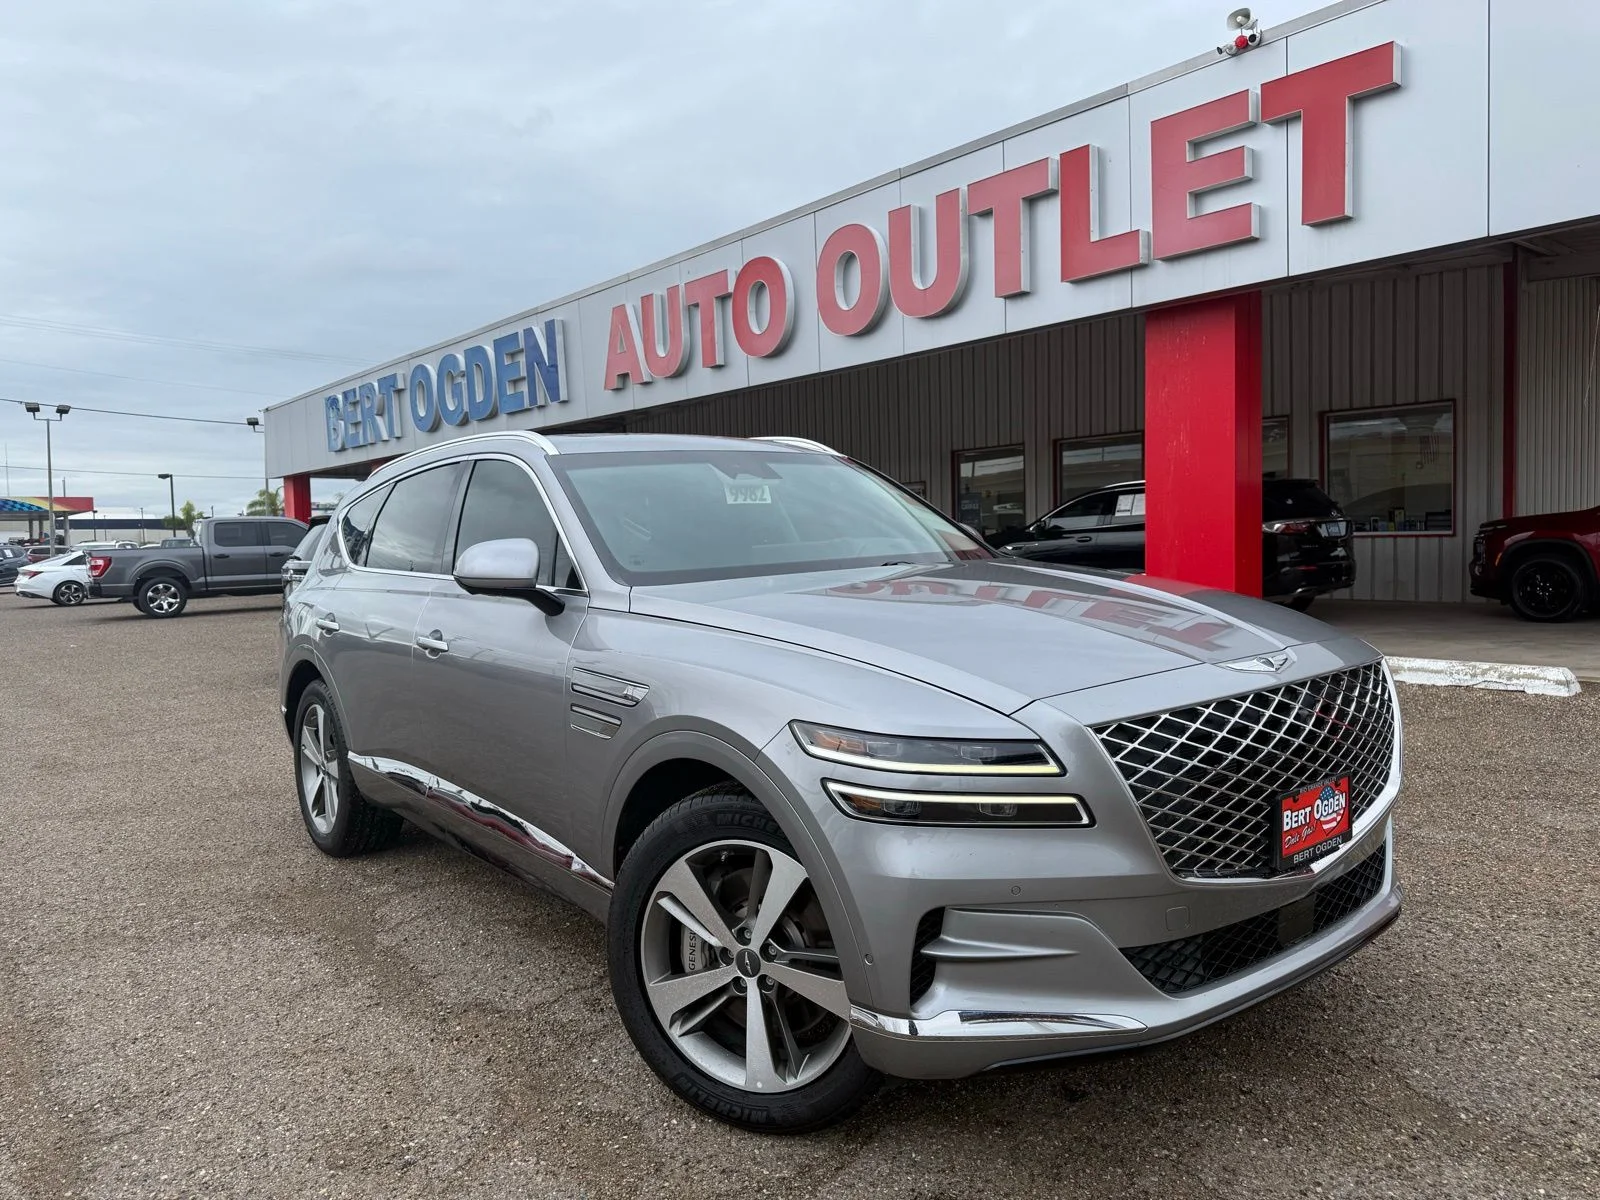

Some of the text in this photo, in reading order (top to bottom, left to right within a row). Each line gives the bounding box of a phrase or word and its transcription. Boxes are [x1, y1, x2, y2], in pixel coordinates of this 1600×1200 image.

[324, 40, 1402, 452] BERT OGDEN AUTO OUTLET
[729, 485, 768, 502] 9982
[1283, 792, 1346, 832] BERT OGDEN
[1293, 835, 1342, 864] BERT OGDEN
[688, 930, 697, 971] GENESI
